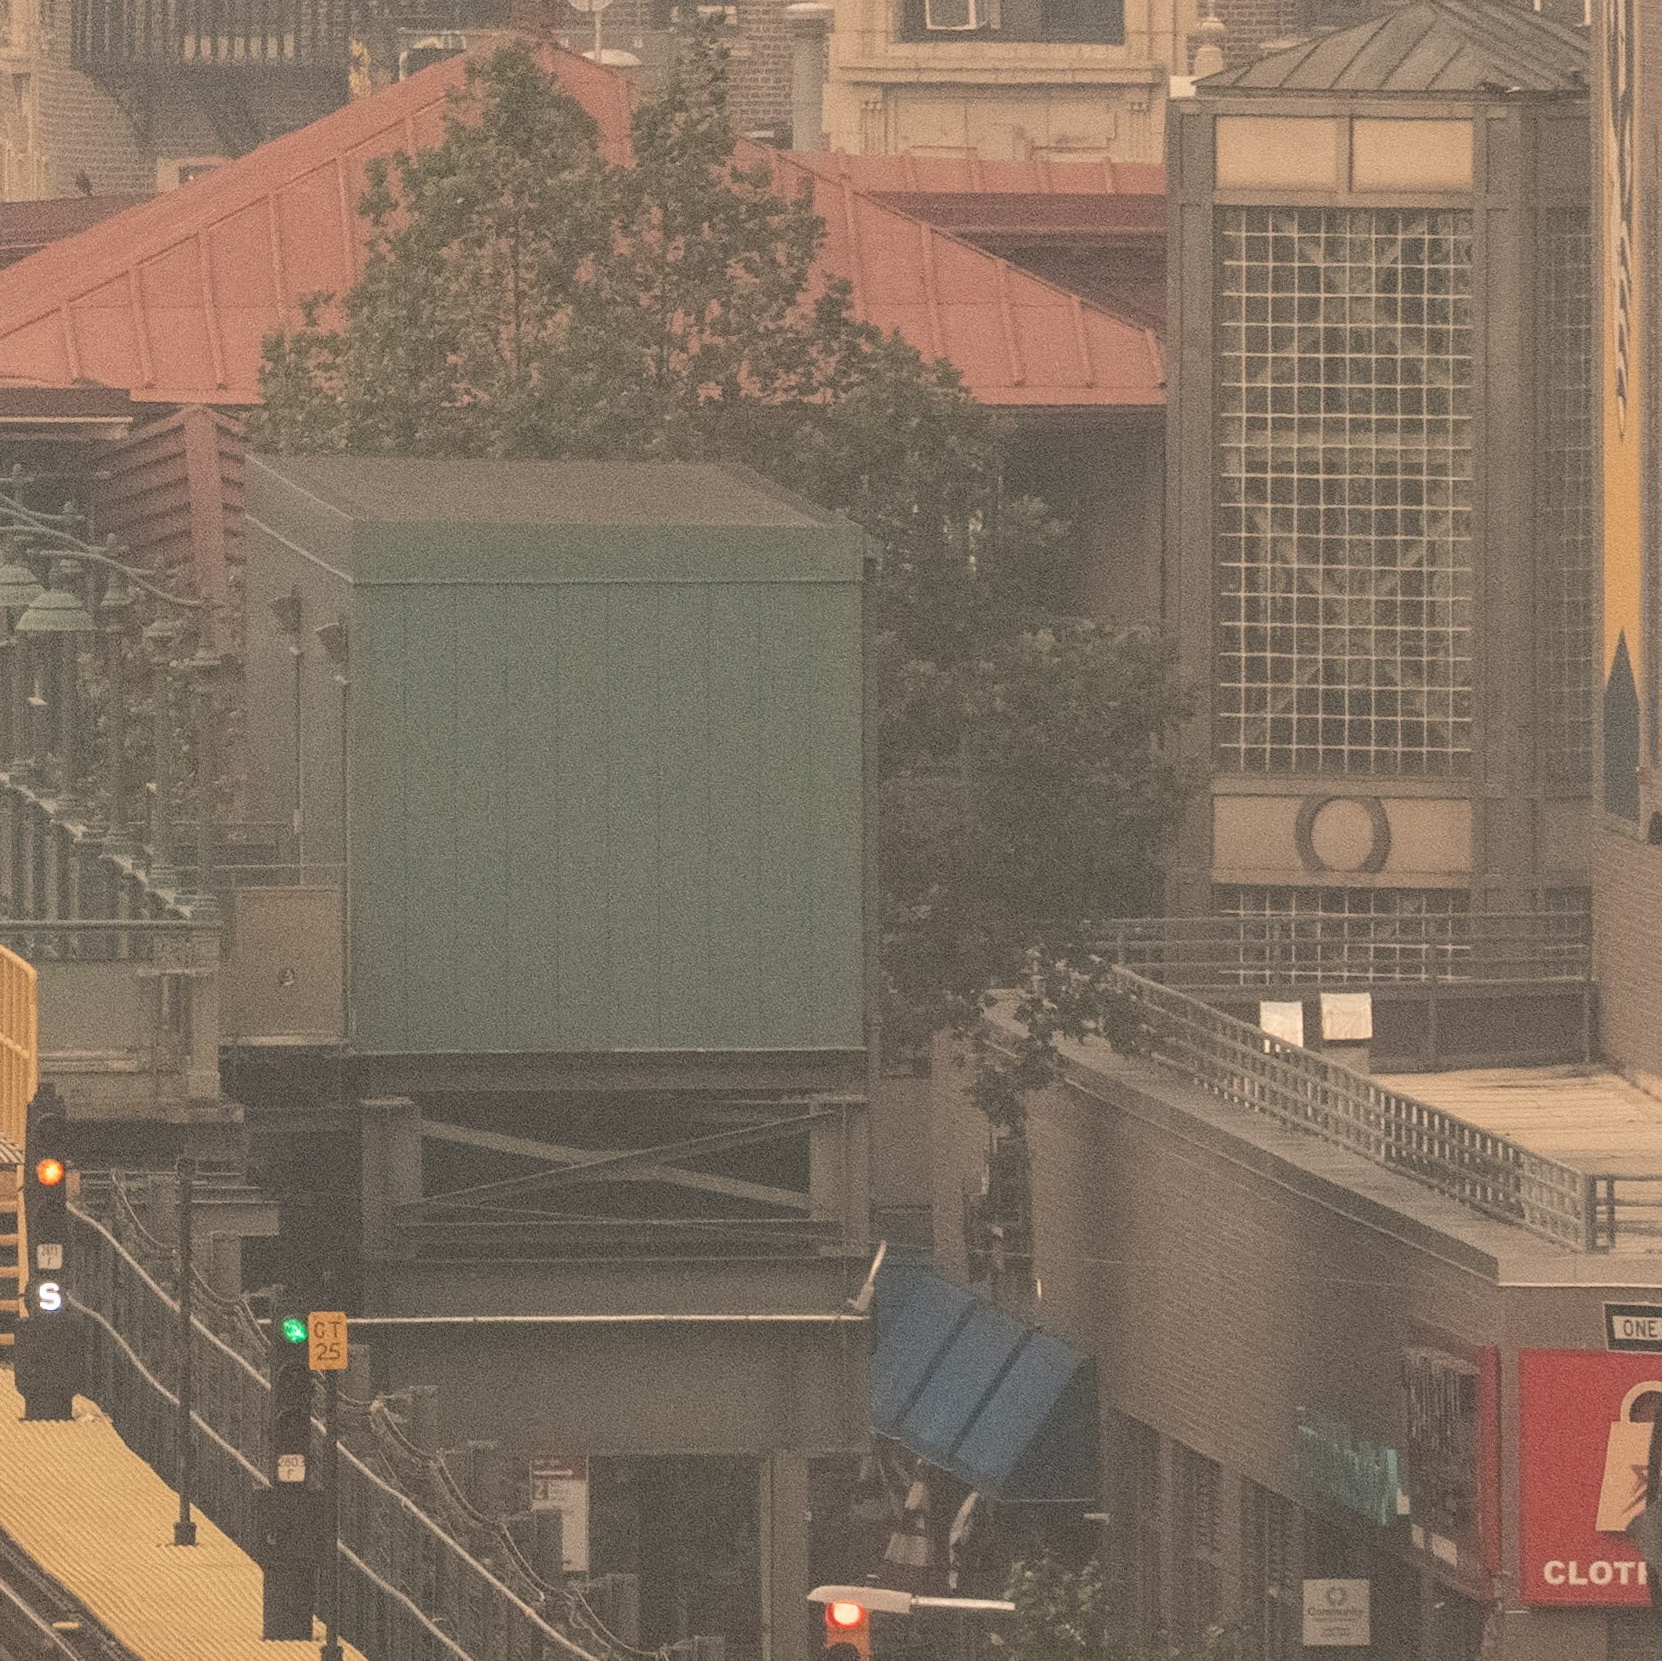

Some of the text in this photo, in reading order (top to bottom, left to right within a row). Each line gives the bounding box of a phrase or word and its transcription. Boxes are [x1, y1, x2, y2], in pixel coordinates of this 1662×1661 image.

[39, 1282, 62, 1311] S
[1623, 1319, 1658, 1338] ONE
[315, 1342, 341, 1360] 25
